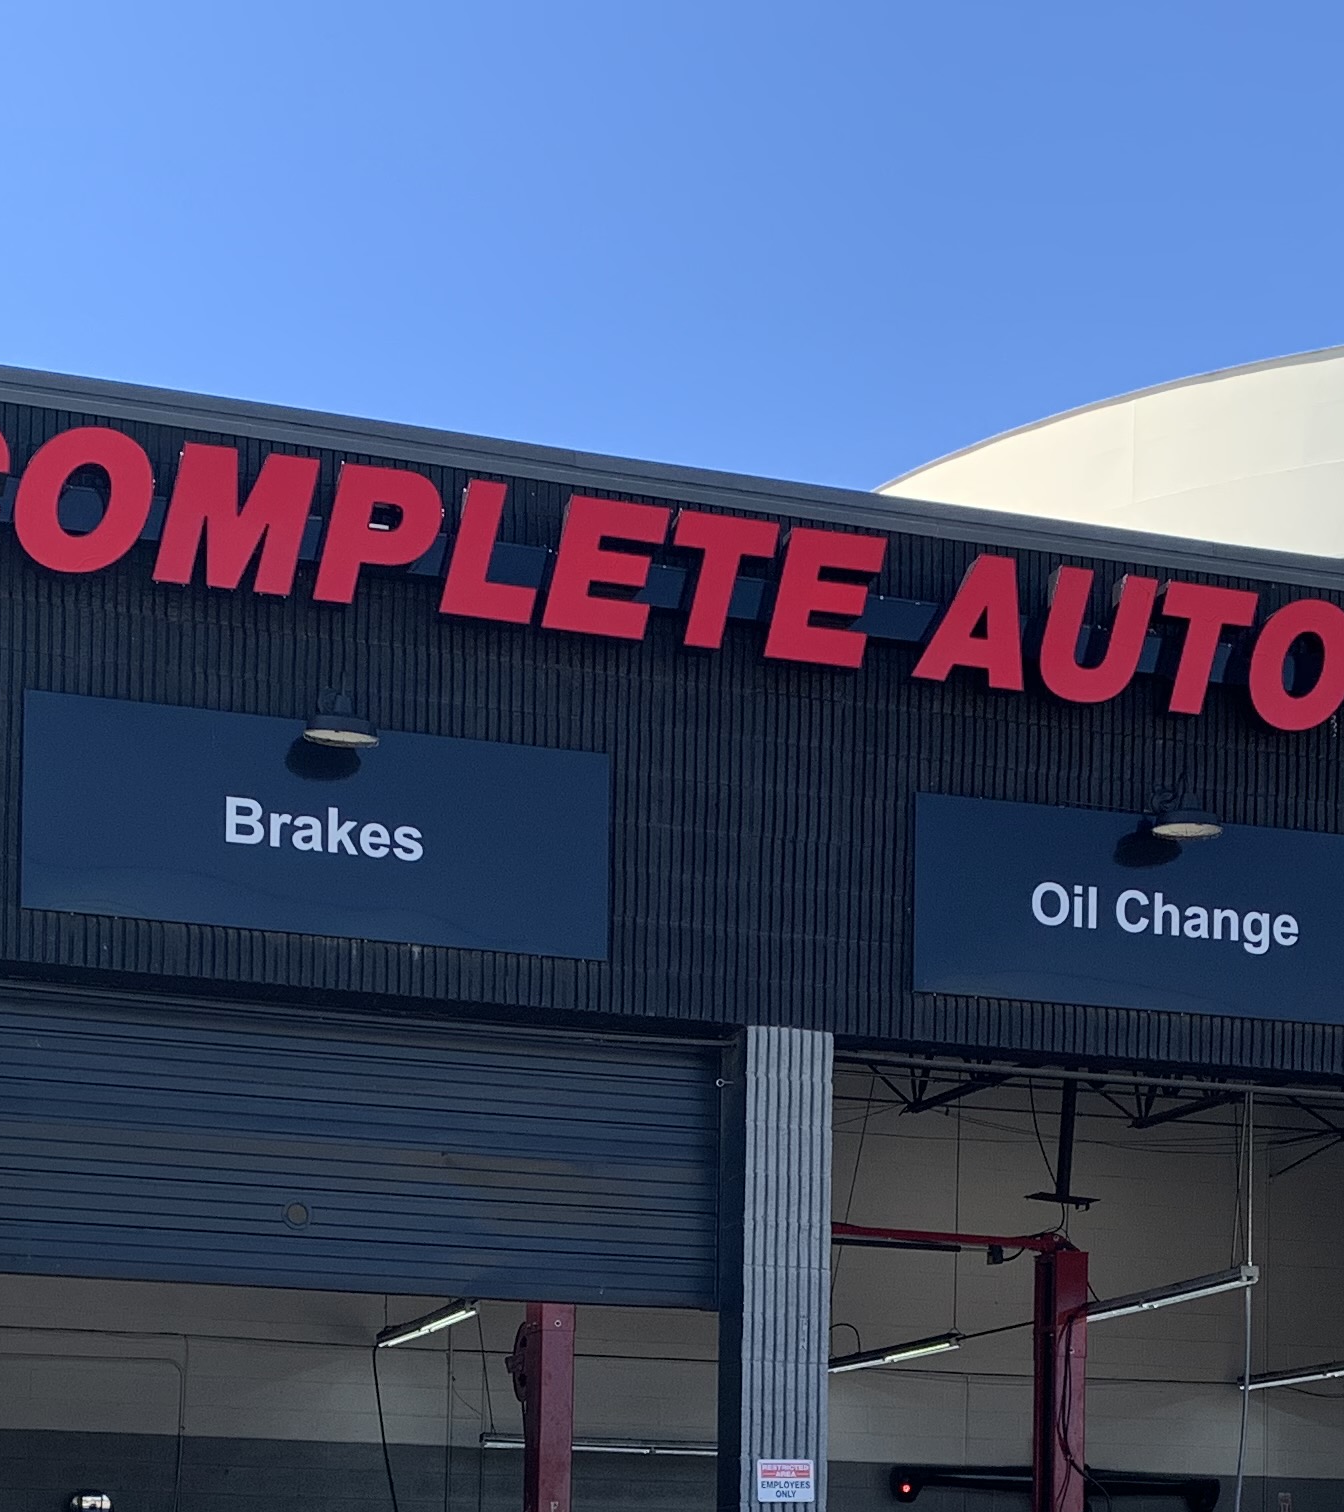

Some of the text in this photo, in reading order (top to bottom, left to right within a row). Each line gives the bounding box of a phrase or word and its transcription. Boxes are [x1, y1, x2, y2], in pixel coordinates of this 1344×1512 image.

[224, 796, 424, 862] Brakes
[1031, 881, 1300, 955] Oil Change
[776, 1490, 796, 1498] ONLY
